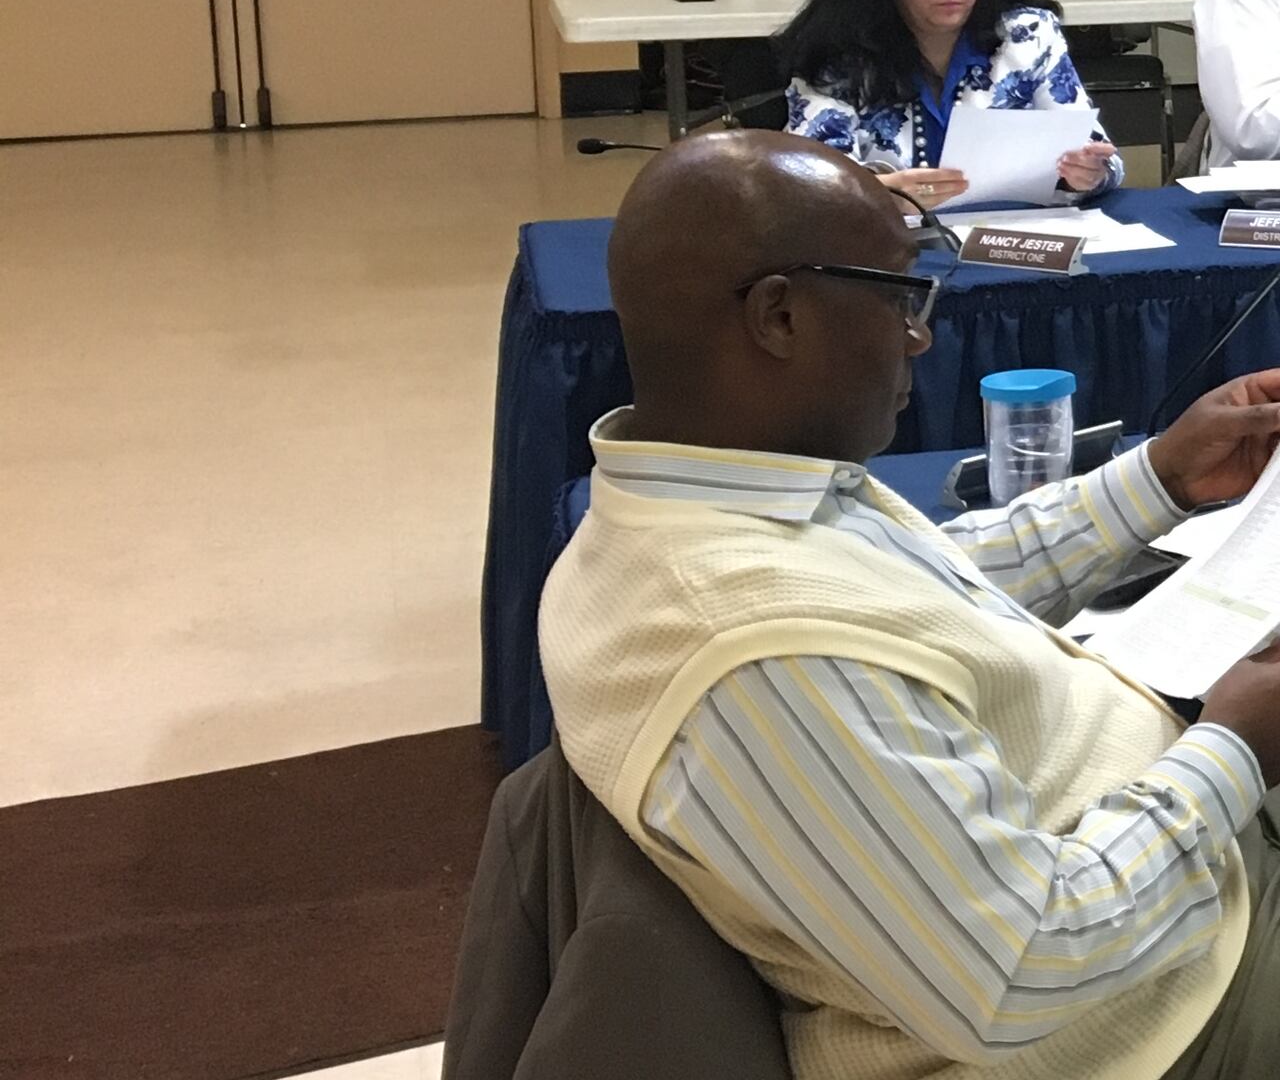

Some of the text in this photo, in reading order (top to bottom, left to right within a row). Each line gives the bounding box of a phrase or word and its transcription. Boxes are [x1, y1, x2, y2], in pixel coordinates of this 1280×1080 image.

[1250, 217, 1280, 228] JEFF
[979, 234, 1065, 252] NANCY JESTER
[988, 249, 1047, 264] DISTRICT ONE
